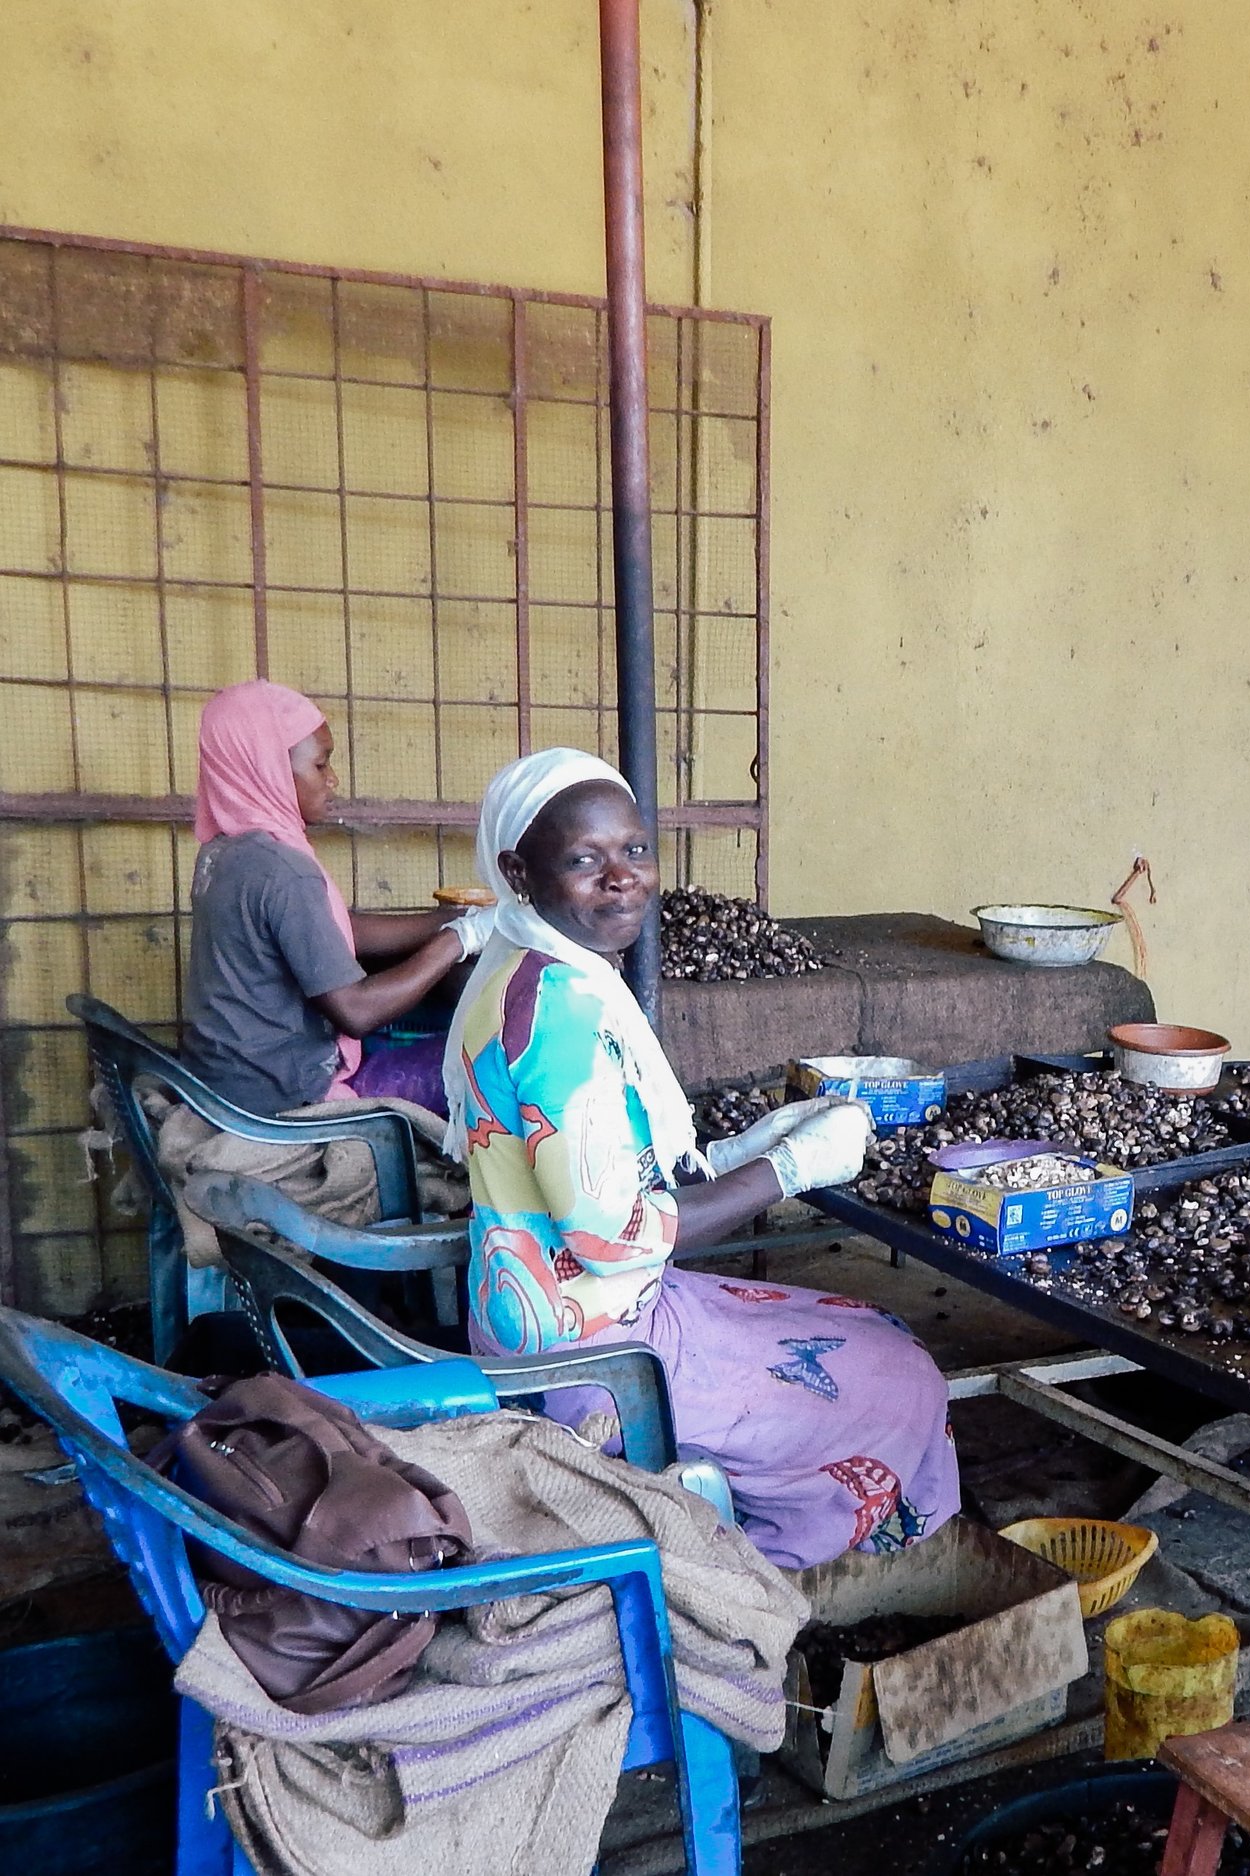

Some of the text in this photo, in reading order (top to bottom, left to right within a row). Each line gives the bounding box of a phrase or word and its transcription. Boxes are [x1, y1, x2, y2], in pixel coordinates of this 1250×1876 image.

[864, 1081, 909, 1089] TOP GLOVE
[1047, 1186, 1092, 1201] TOP GLOVE
